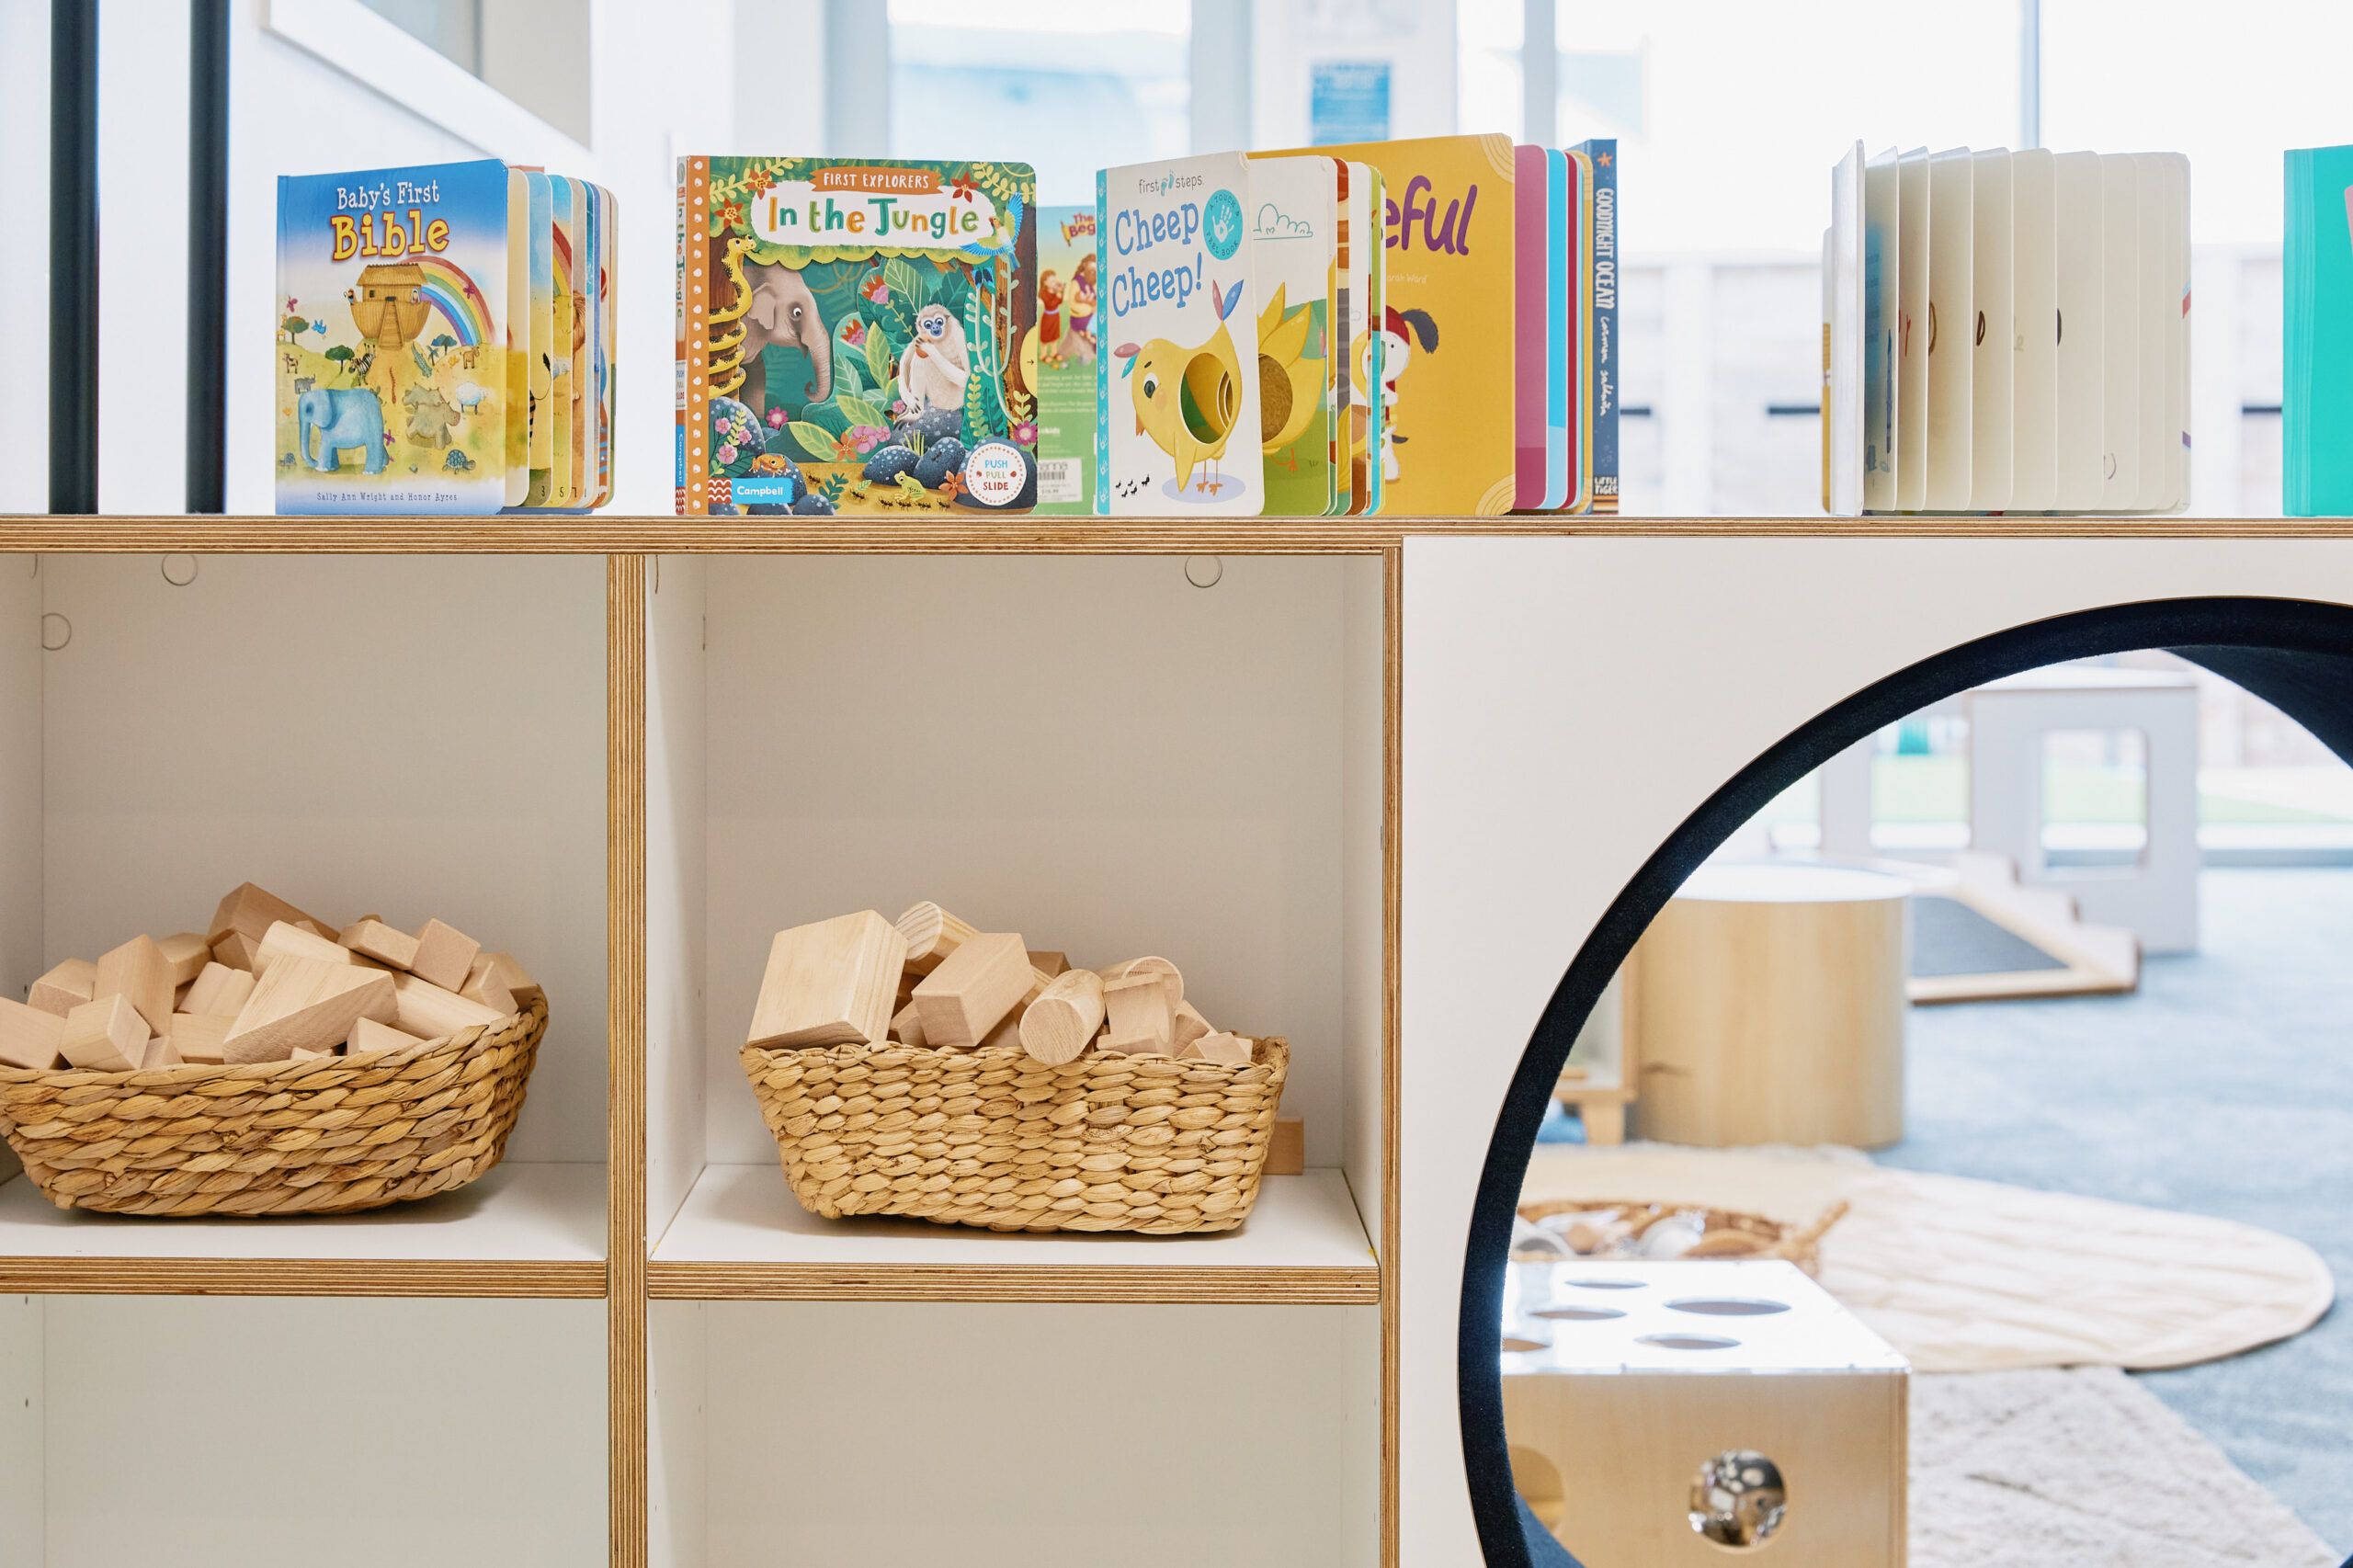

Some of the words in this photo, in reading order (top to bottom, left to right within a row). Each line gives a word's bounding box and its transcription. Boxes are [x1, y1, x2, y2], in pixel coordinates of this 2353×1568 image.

[824, 172, 858, 187] FIRST
[863, 173, 929, 189] EXPLORERS
[1139, 178, 1160, 194] first
[1175, 174, 1203, 191] steps
[336, 182, 391, 210] Baby's
[397, 179, 440, 205] First
[1213, 193, 1236, 208] TOUCH
[768, 196, 798, 233] In
[809, 198, 866, 233] the
[868, 198, 980, 239] Jungle
[1596, 187, 1614, 258] GOODNIGHT
[329, 209, 450, 262] Bible
[1115, 202, 1199, 256] Cheep
[1206, 231, 1220, 254] FEEL
[1221, 239, 1239, 256] BOOK
[1112, 251, 1202, 317] Cheep!
[1596, 261, 1615, 310] OCEAN
[984, 460, 1008, 469] PUSH
[985, 471, 1006, 479] PULL
[540, 485, 546, 497] 3
[559, 486, 564, 498] 5
[736, 485, 783, 497] Campbell
[983, 482, 1009, 491] SLIDE
[316, 492, 338, 502] Sally
[341, 492, 357, 501] Ann
[359, 492, 387, 502] Wright
[390, 492, 404, 501] and
[407, 492, 431, 501] Honor
[435, 492, 458, 502] Ayres
